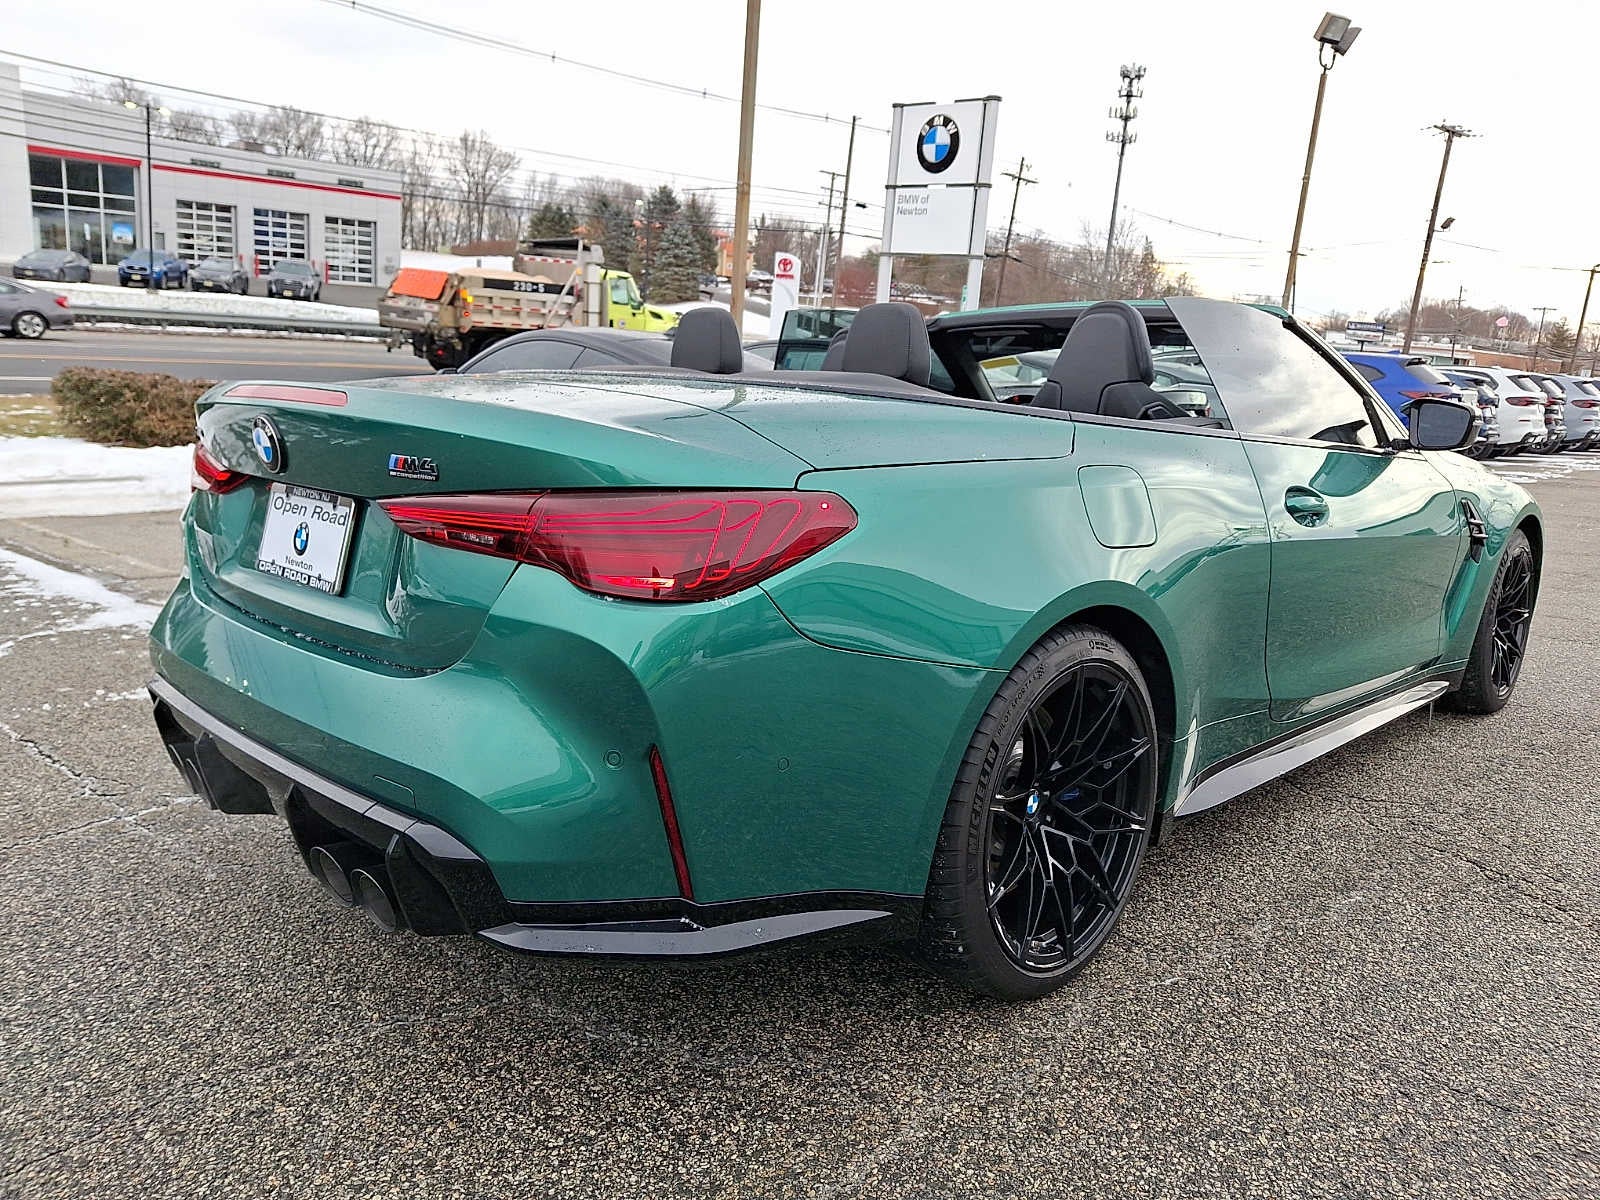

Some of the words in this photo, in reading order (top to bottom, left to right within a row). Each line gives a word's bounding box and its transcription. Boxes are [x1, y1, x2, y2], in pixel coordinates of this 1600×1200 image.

[920, 114, 958, 136] BMW
[897, 194, 919, 204] BMW
[920, 194, 930, 204] of
[896, 206, 928, 216] Newton
[274, 496, 307, 516] Open
[311, 505, 348, 527] Road
[285, 555, 313, 572] Newton
[259, 561, 283, 576] OPEN
[284, 568, 308, 585] ROAD
[309, 576, 332, 593] BMW
[968, 741, 998, 854] MICHELIN
